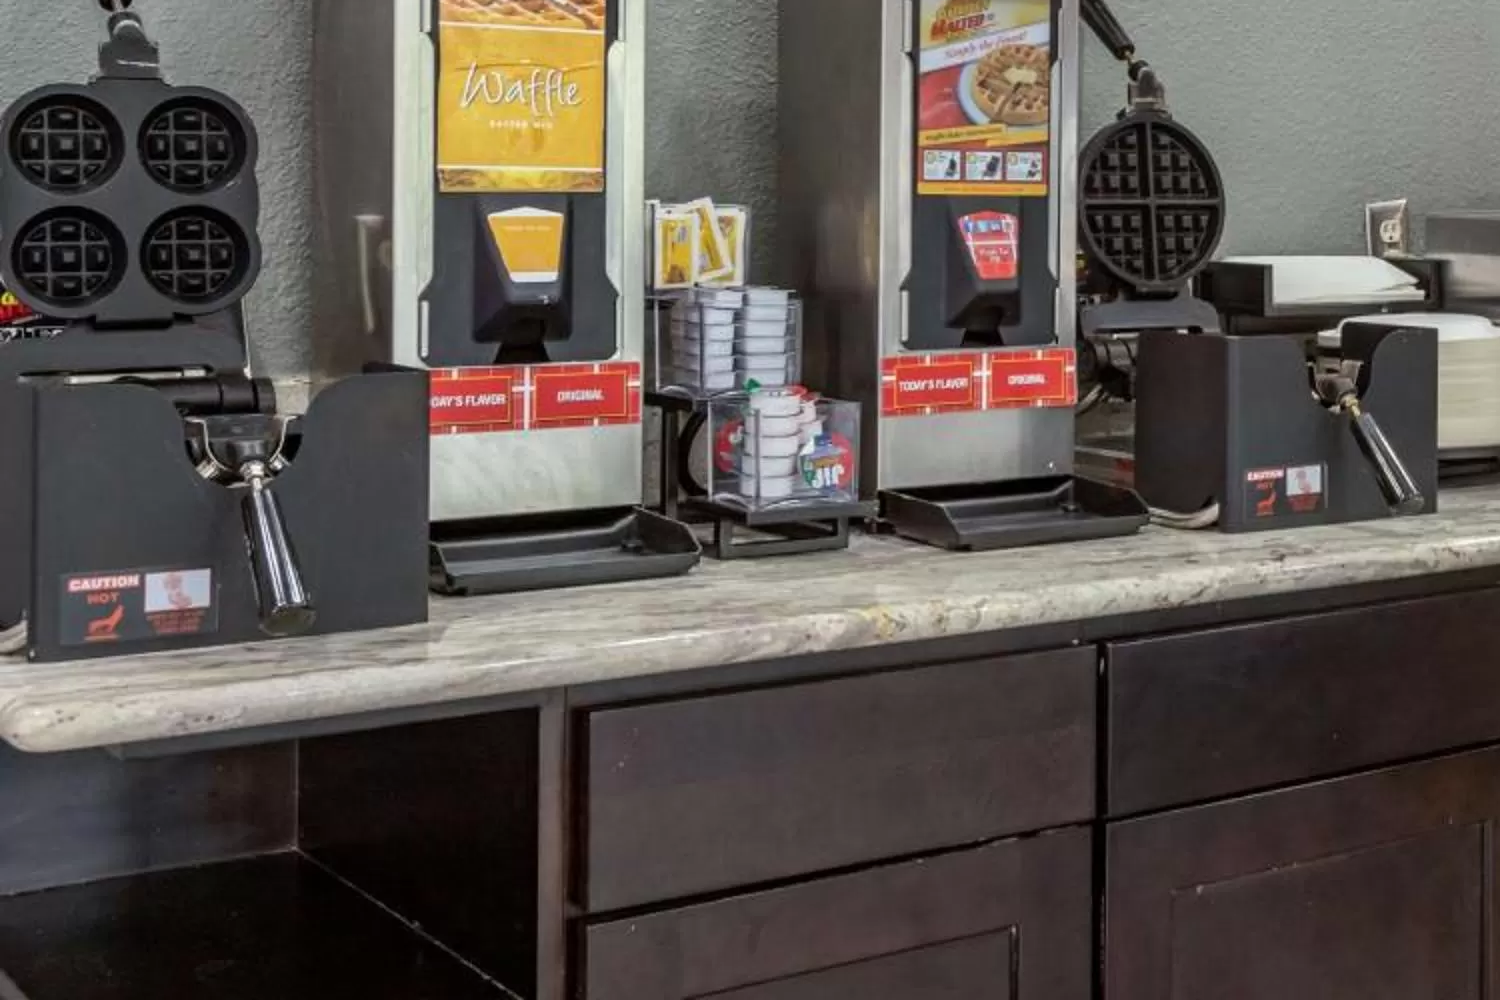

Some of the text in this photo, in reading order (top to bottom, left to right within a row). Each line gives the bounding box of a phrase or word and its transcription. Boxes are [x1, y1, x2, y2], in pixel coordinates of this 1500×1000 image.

[460, 62, 582, 117] Waffle
[430, 392, 506, 408] DAY'S FLAVOR
[557, 388, 605, 403] ORIGINAL
[67, 573, 141, 593] CAUTION
[87, 590, 121, 605] HOT
